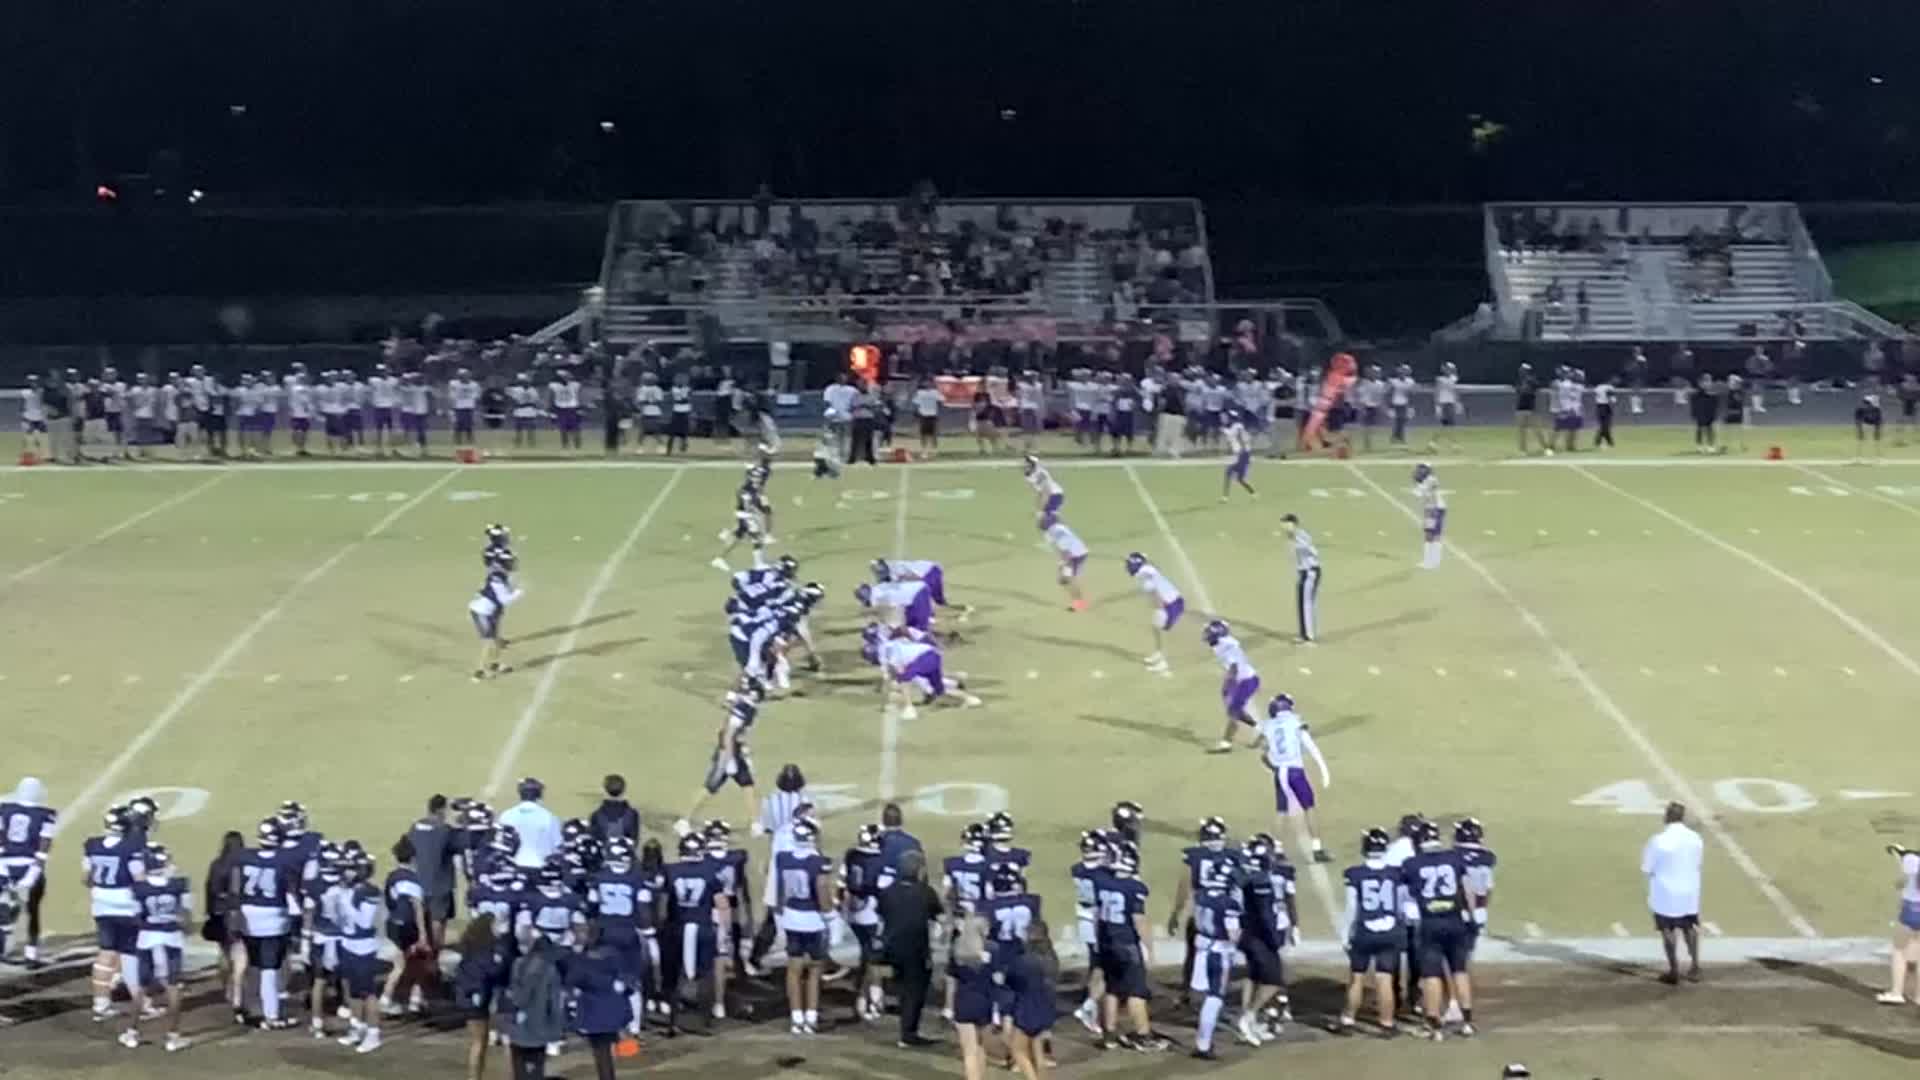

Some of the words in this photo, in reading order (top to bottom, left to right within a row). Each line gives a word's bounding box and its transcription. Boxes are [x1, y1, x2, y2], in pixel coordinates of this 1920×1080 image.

[1569, 778, 1818, 815] 40
[91, 854, 121, 885] 77
[1419, 863, 1458, 899] 73
[1361, 878, 1395, 912] 54
